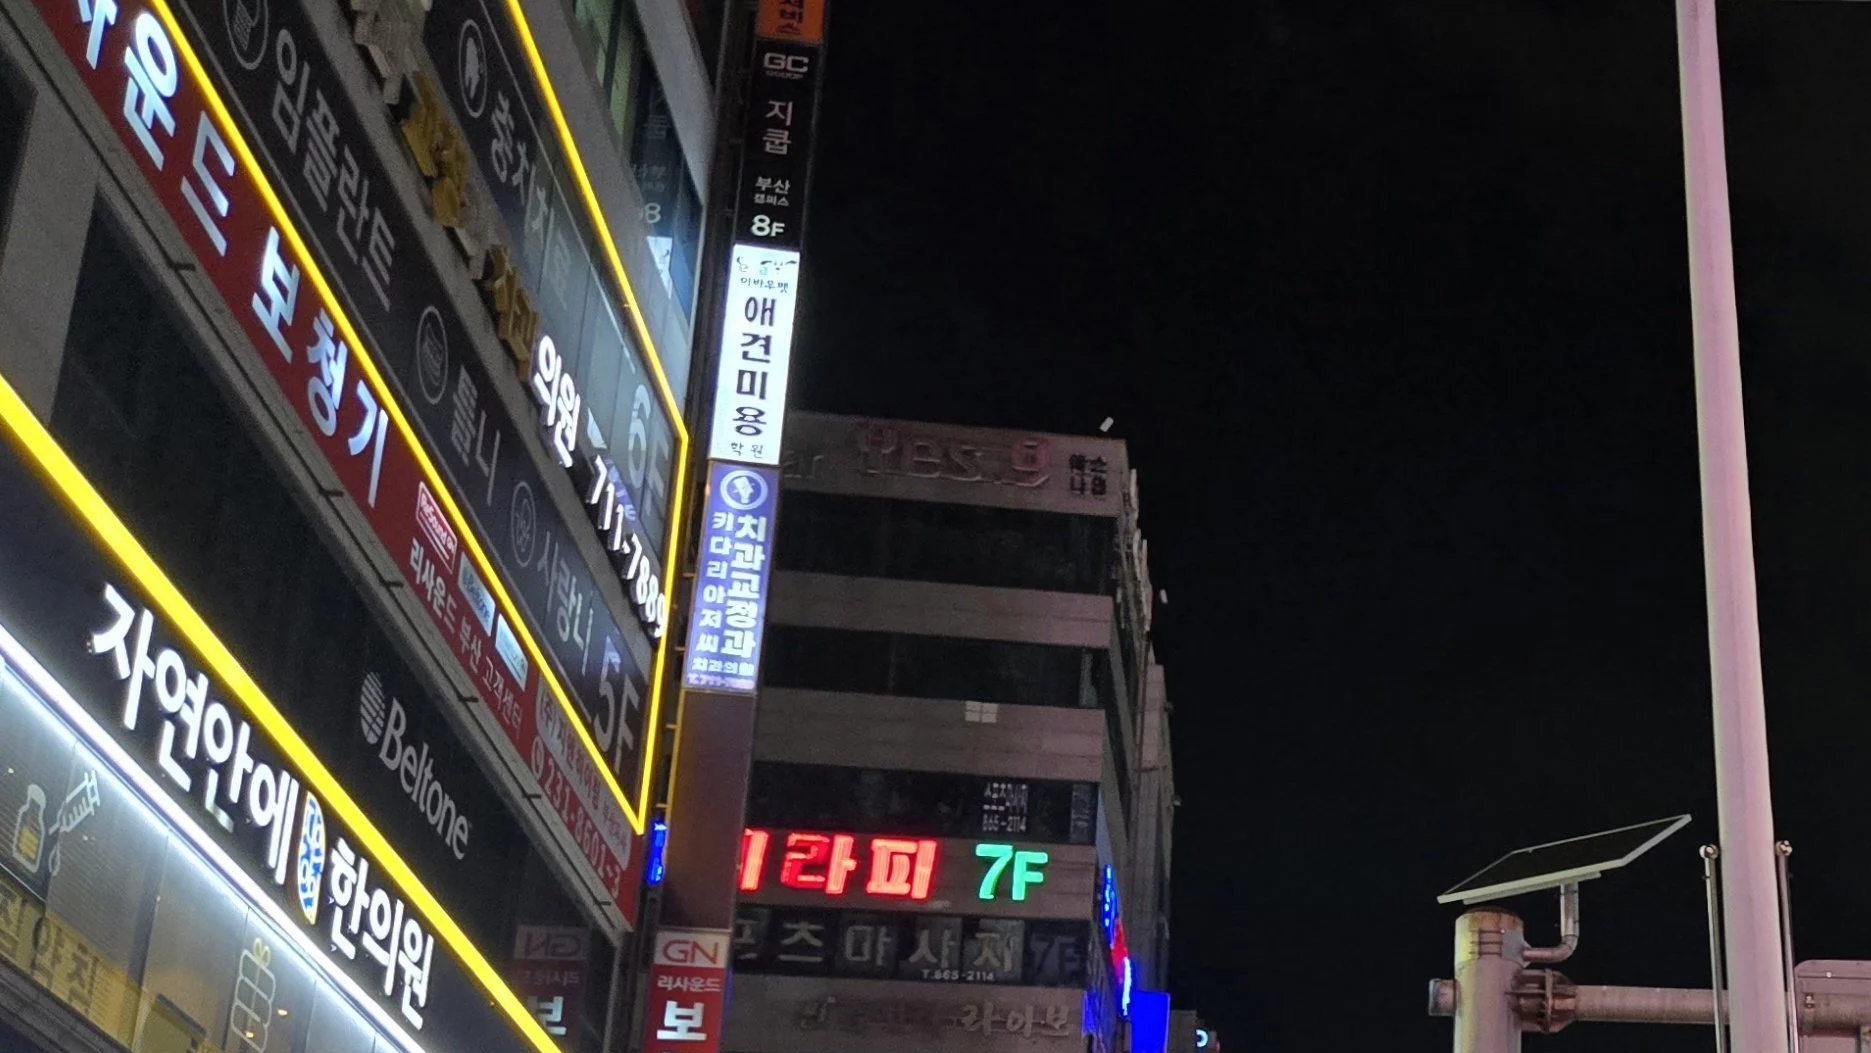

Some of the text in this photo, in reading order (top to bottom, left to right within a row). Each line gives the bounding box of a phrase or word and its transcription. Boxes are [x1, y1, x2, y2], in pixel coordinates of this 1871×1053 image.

[272, 27, 397, 313] 임플란트
[755, 176, 791, 196] 부산
[761, 99, 795, 156] 지쿱
[751, 214, 786, 238] 8F
[251, 225, 390, 509] 보청기
[537, 334, 582, 469] 의원
[732, 296, 778, 438] 애견미용
[730, 441, 764, 460] 학원
[410, 536, 458, 634] 리사운드
[459, 622, 483, 678] 부산
[537, 530, 594, 677] 사랑니
[695, 511, 736, 655] 키다리아저씨
[719, 513, 768, 660] 치과교정과
[92, 581, 434, 1031] 자연안에 한의원
[378, 697, 471, 861] Beltone
[975, 843, 1049, 901] 7F
[657, 975, 723, 993] 리사운드
[662, 938, 719, 965] GN
